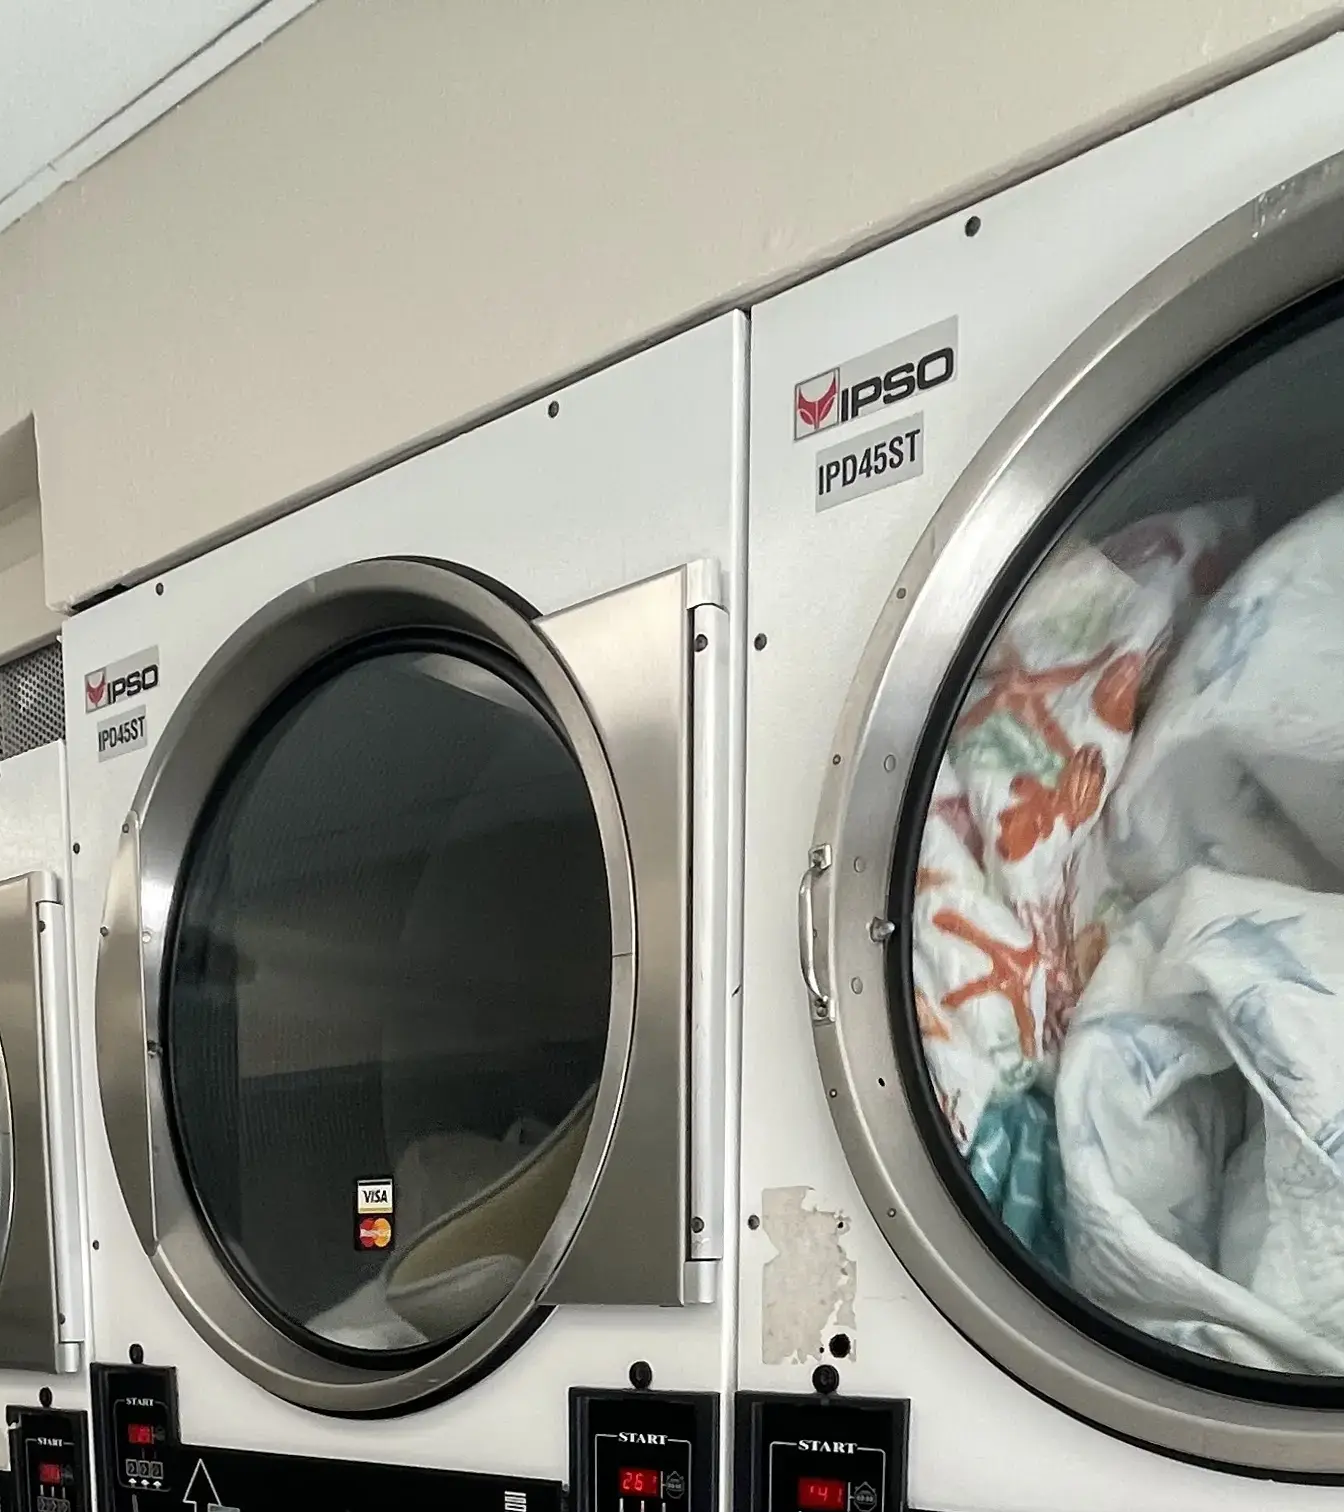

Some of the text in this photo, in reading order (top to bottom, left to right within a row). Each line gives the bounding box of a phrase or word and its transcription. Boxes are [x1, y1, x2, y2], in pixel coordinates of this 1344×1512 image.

[840, 347, 954, 423] IPSO
[818, 429, 921, 495] IPD45ST
[107, 664, 159, 705] IPSO
[98, 716, 146, 752] IPD45ST
[362, 1189, 388, 1203] VISA
[126, 1397, 154, 1406] START
[618, 1432, 668, 1446] START
[798, 1440, 857, 1454] START
